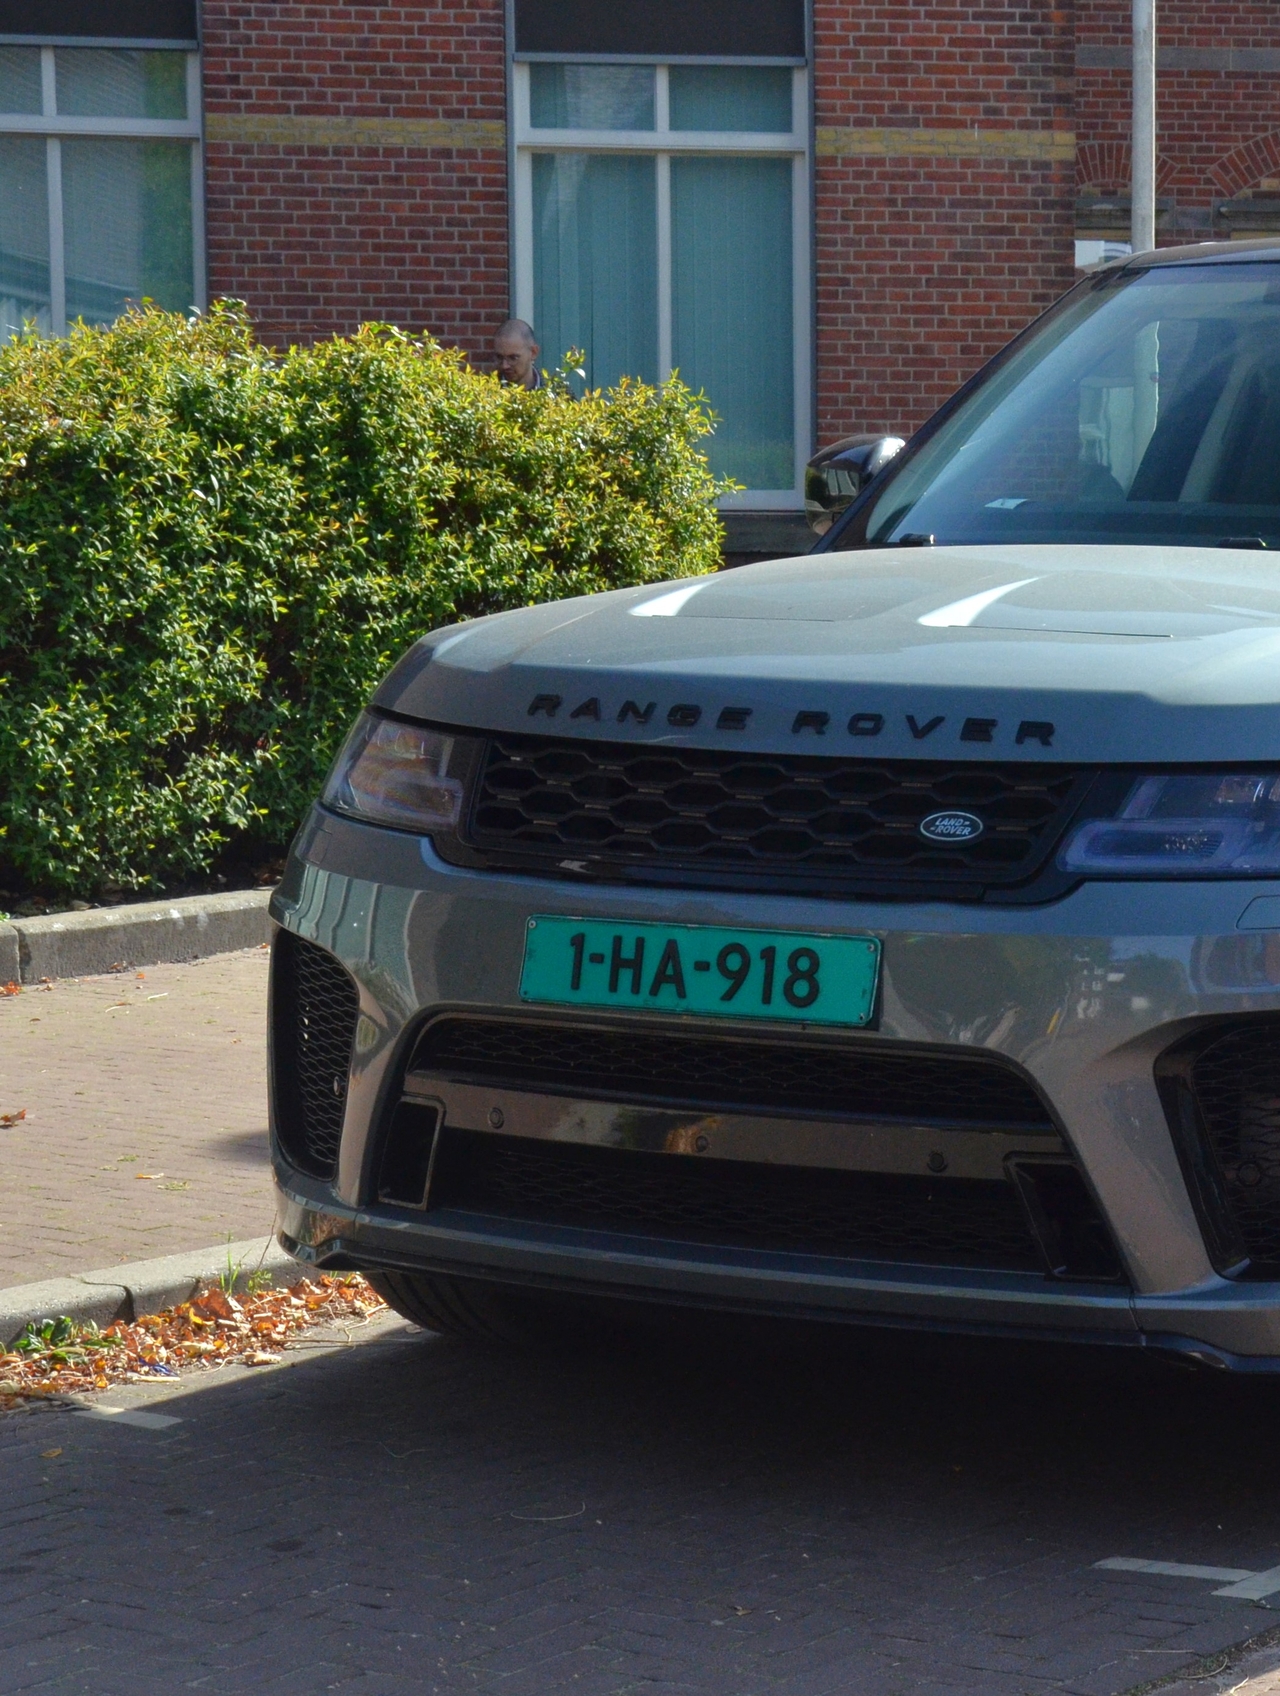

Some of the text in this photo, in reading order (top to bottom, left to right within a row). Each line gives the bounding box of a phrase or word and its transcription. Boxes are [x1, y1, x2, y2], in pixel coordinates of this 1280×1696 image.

[527, 693, 1056, 747] RANGE ROVER
[569, 932, 821, 1009] 1-HA-918
